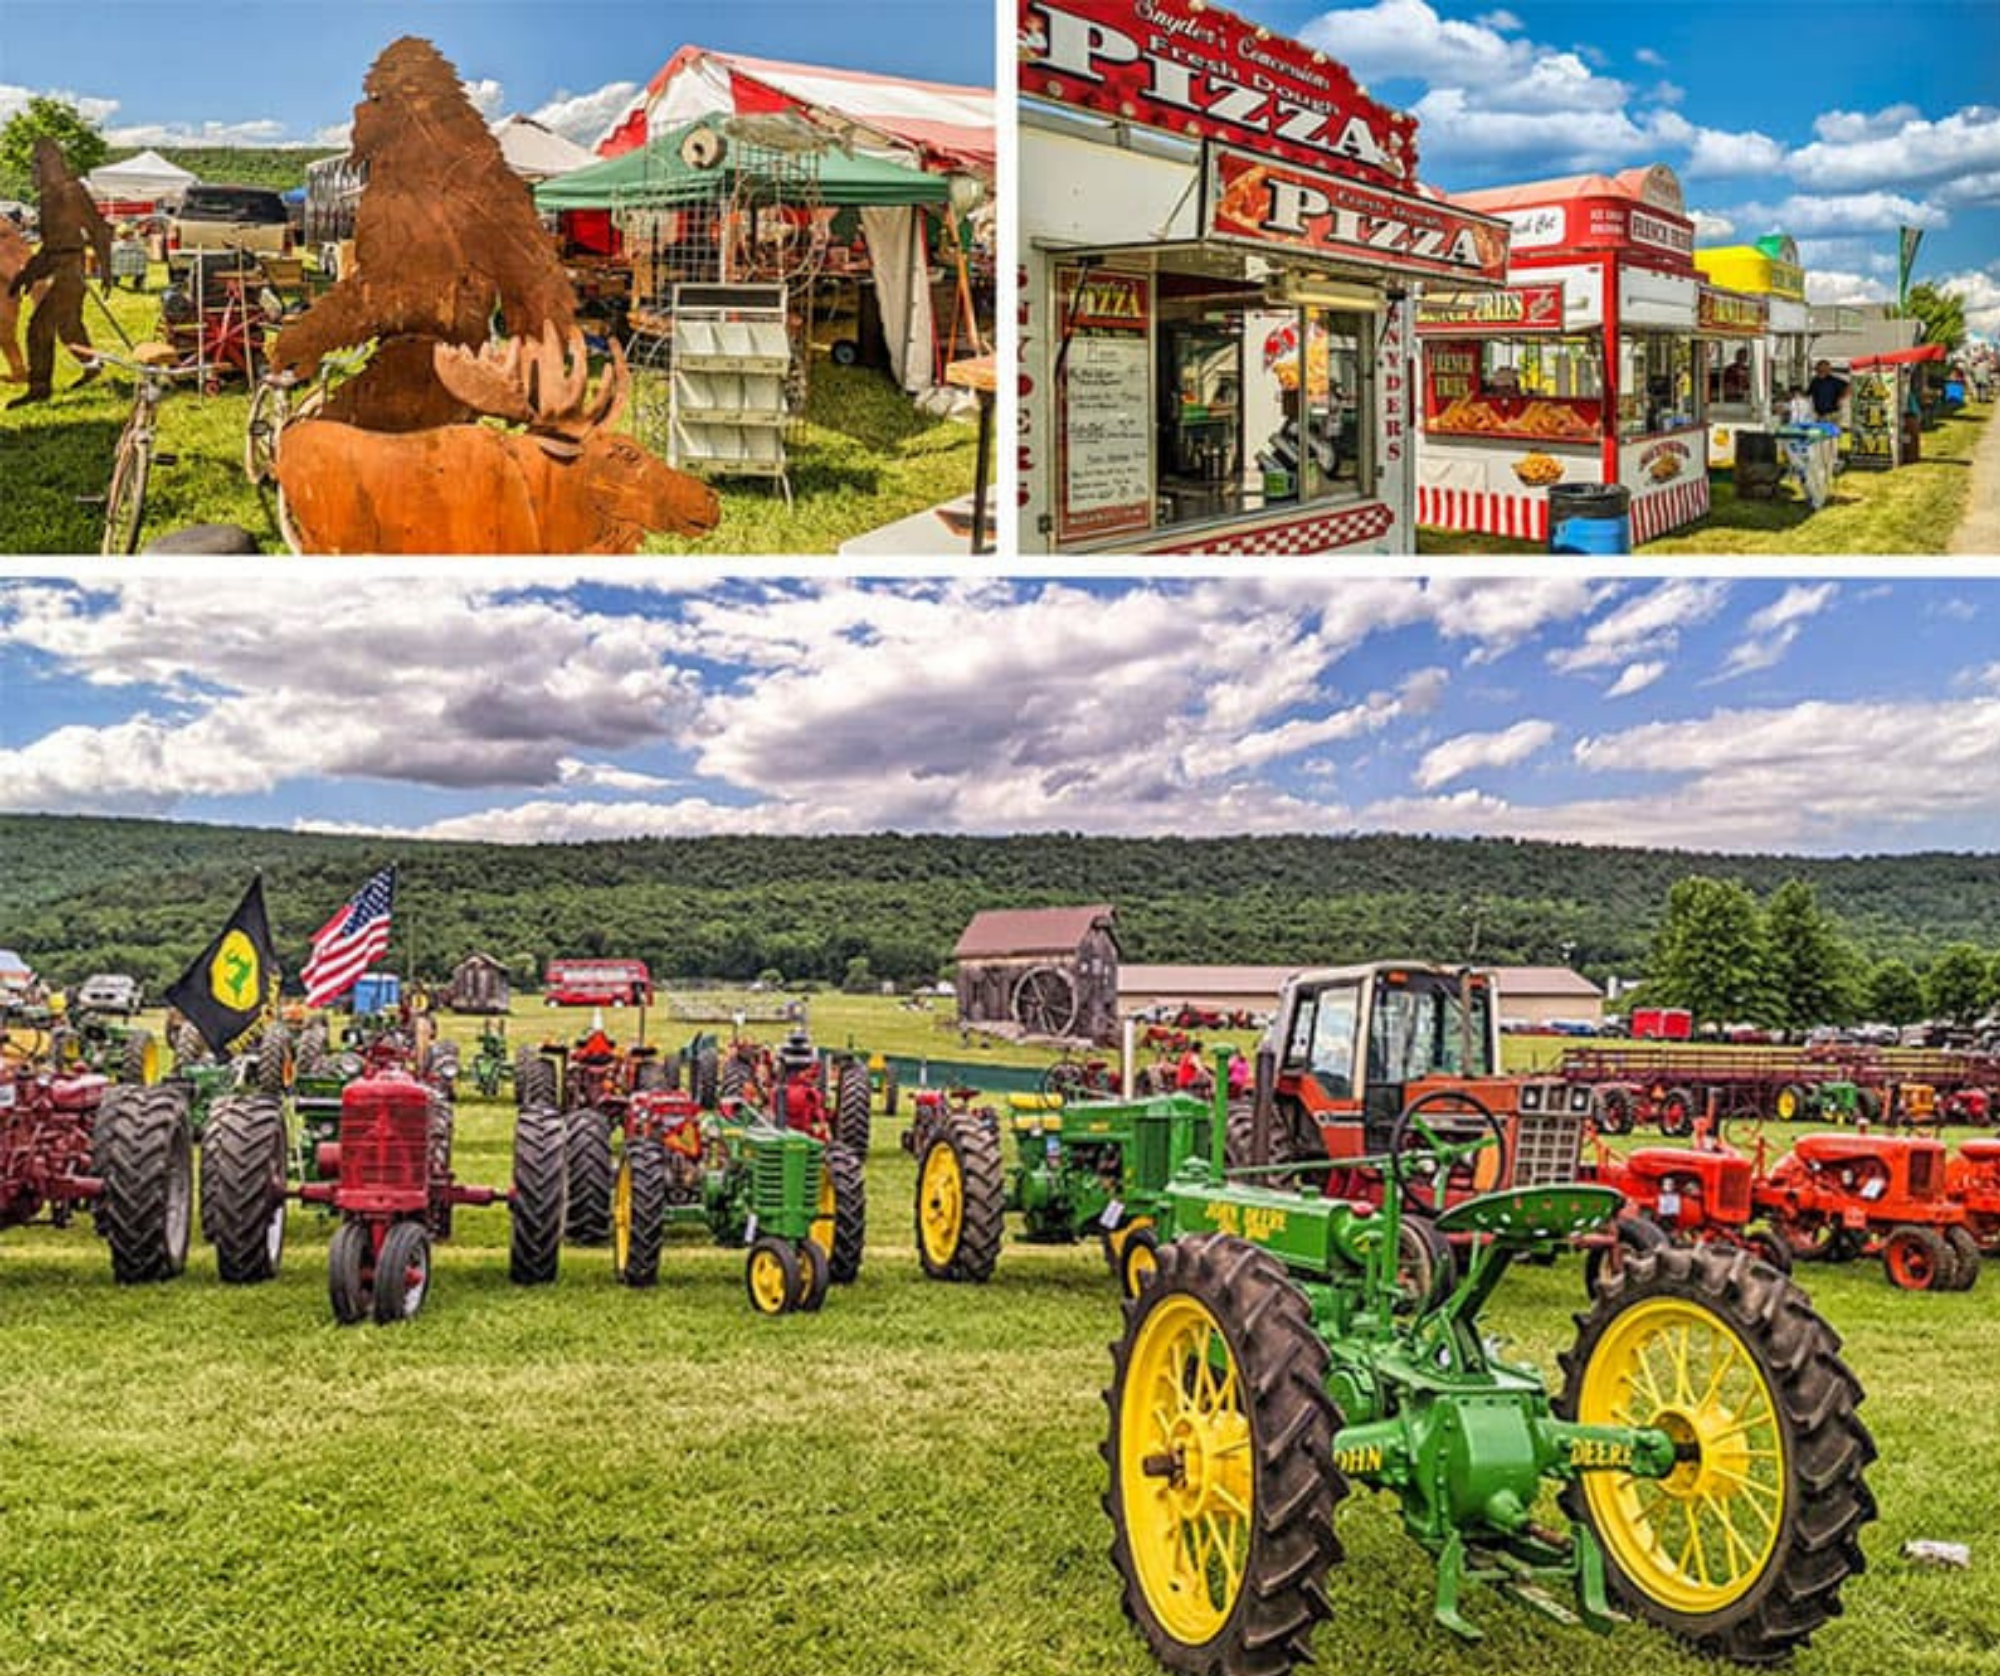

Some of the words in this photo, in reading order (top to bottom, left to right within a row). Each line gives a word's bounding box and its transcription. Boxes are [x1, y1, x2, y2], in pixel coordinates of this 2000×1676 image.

[1030, 2, 1386, 167] PIZZA
[1149, 34, 1240, 81] Fresh
[1252, 72, 1341, 116] Dough
[1260, 177, 1485, 269] PIZZA
[1334, 1443, 1382, 1472] OHN
